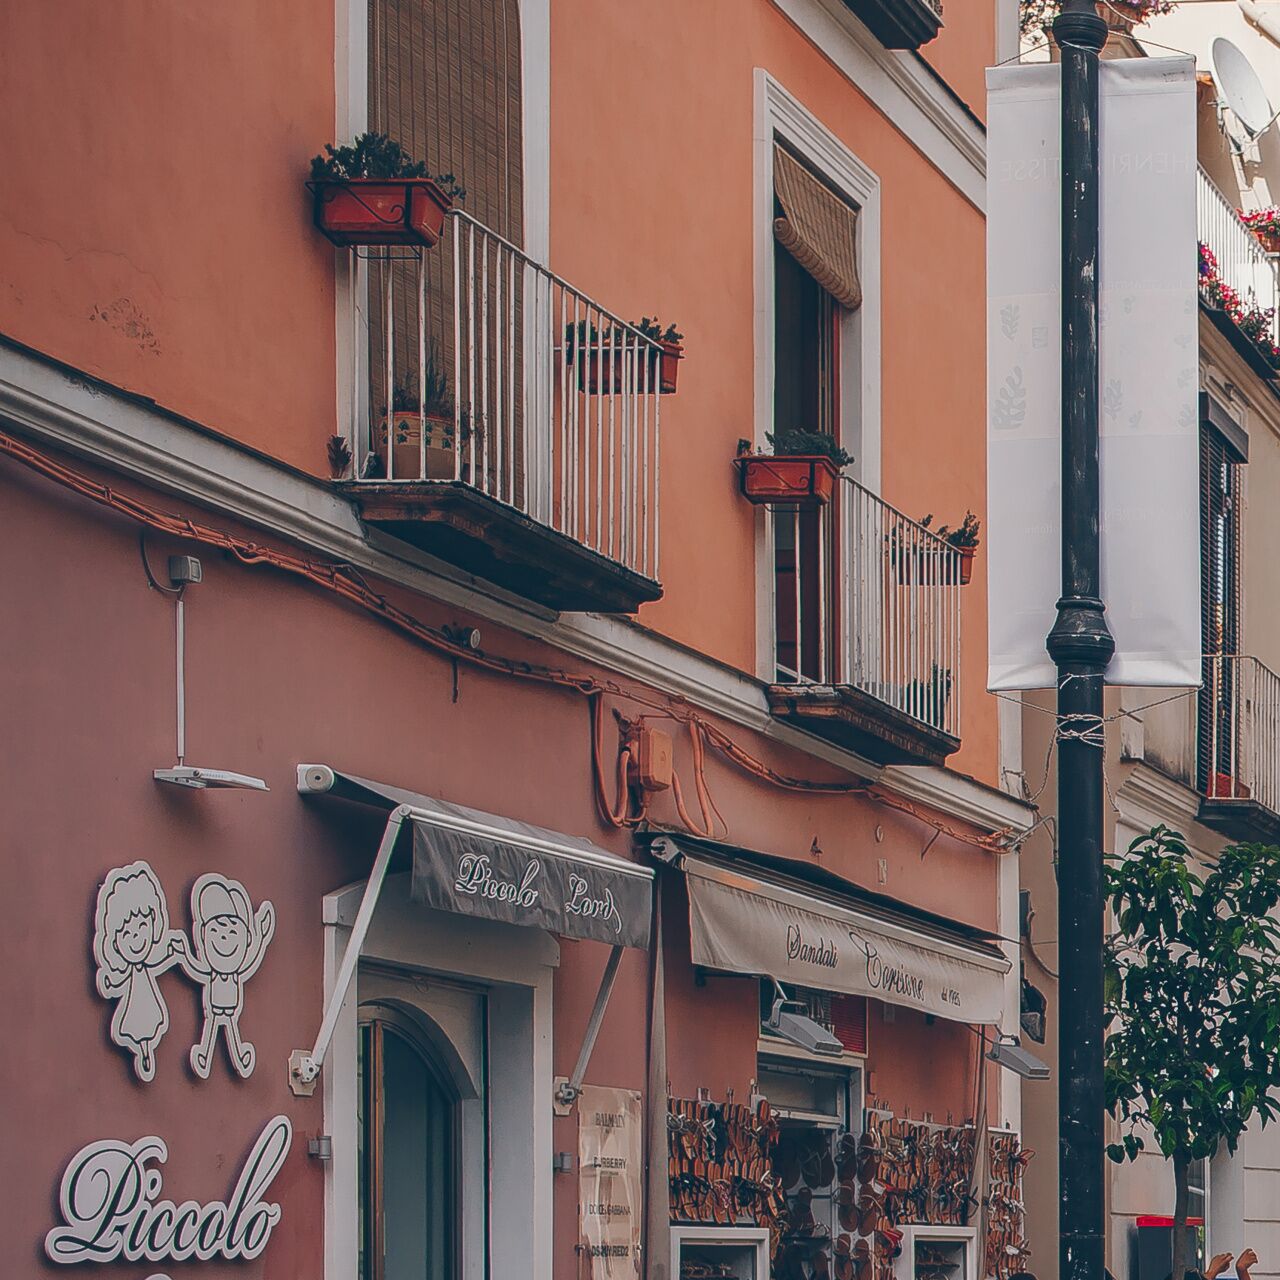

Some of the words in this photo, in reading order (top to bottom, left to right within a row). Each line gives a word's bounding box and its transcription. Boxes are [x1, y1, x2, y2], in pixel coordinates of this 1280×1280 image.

[455, 853, 540, 907] Piccolo
[566, 873, 622, 934] Lord
[787, 924, 837, 969] Sandali
[46, 1115, 292, 1262] Piccolo
